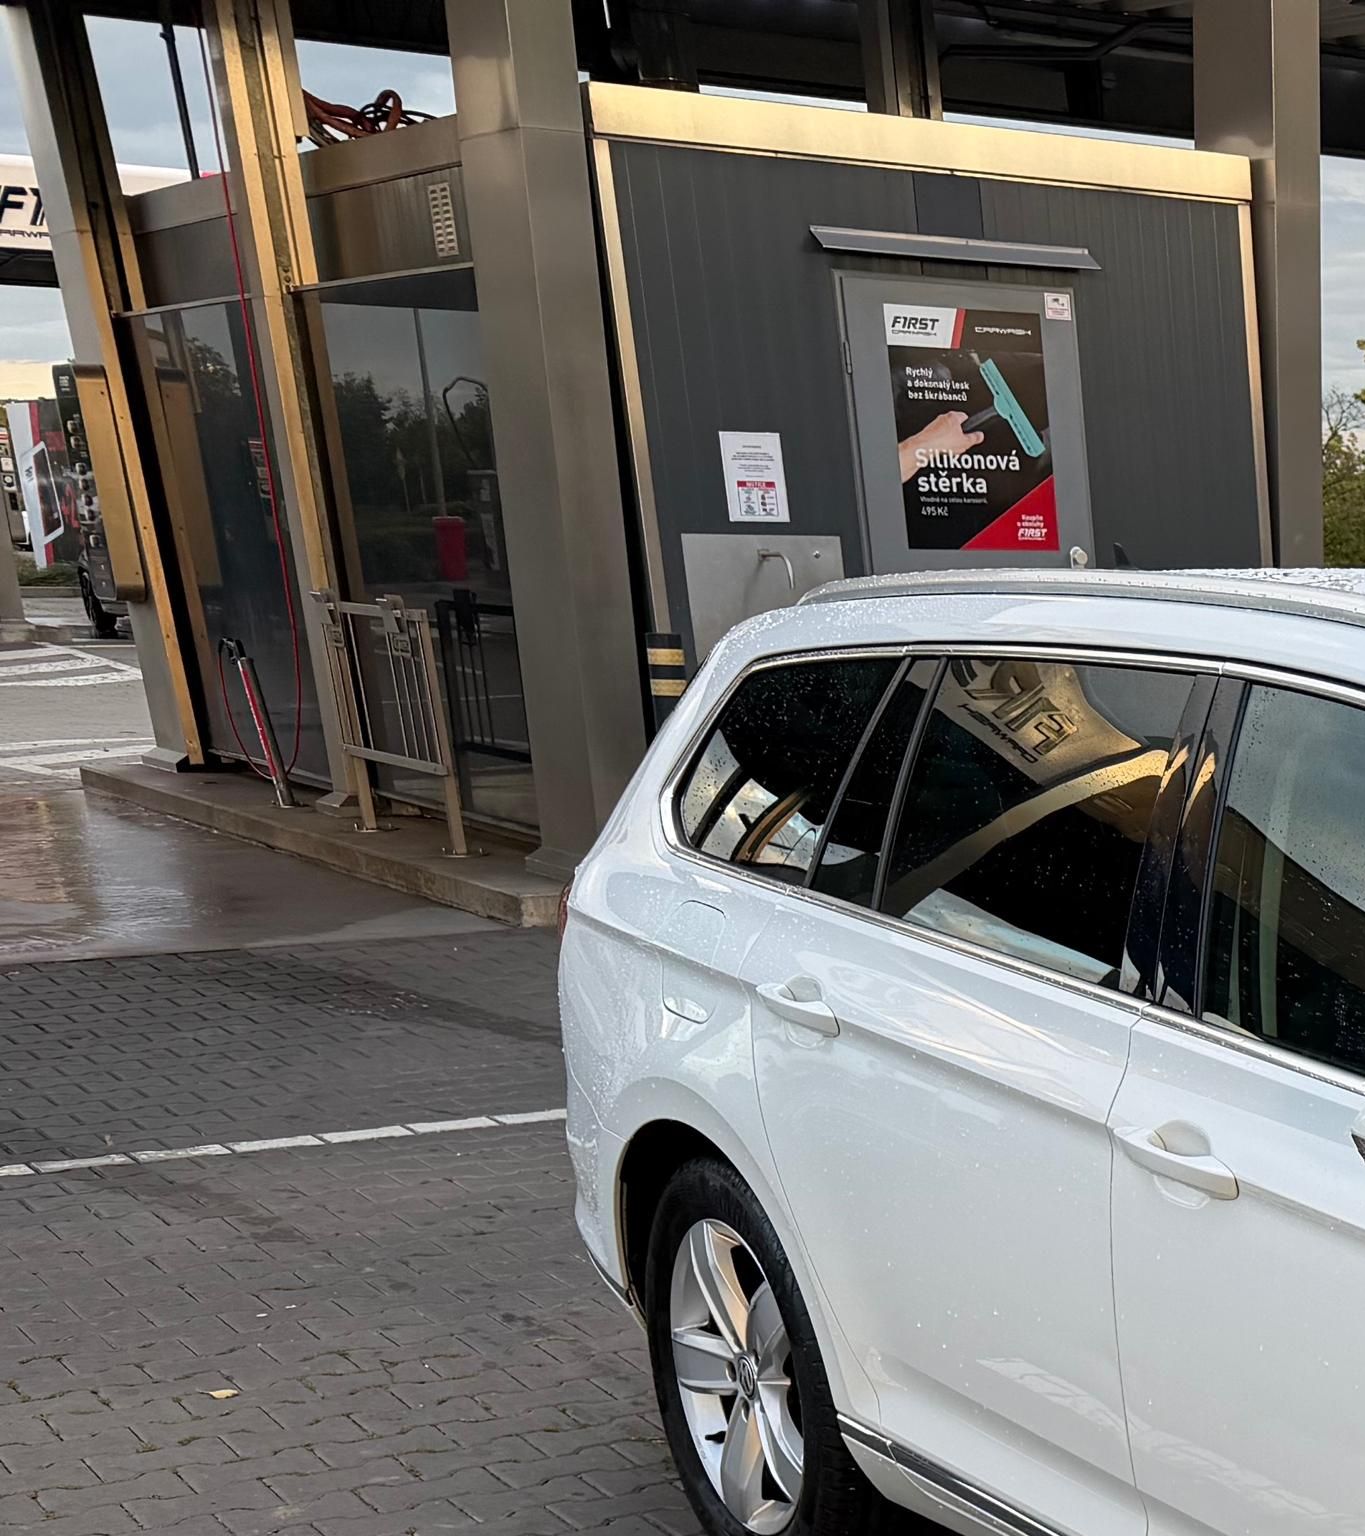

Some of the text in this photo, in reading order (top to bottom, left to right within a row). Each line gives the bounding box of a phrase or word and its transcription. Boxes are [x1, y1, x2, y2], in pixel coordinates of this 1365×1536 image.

[975, 326, 1032, 336] CARWASH
[905, 366, 933, 378] Rychlý
[914, 379, 950, 391] dokonalý
[951, 380, 970, 390] lesk
[908, 390, 968, 402] bez škrábanců
[915, 448, 1020, 471] Silikonová
[918, 470, 987, 494] stěrka
